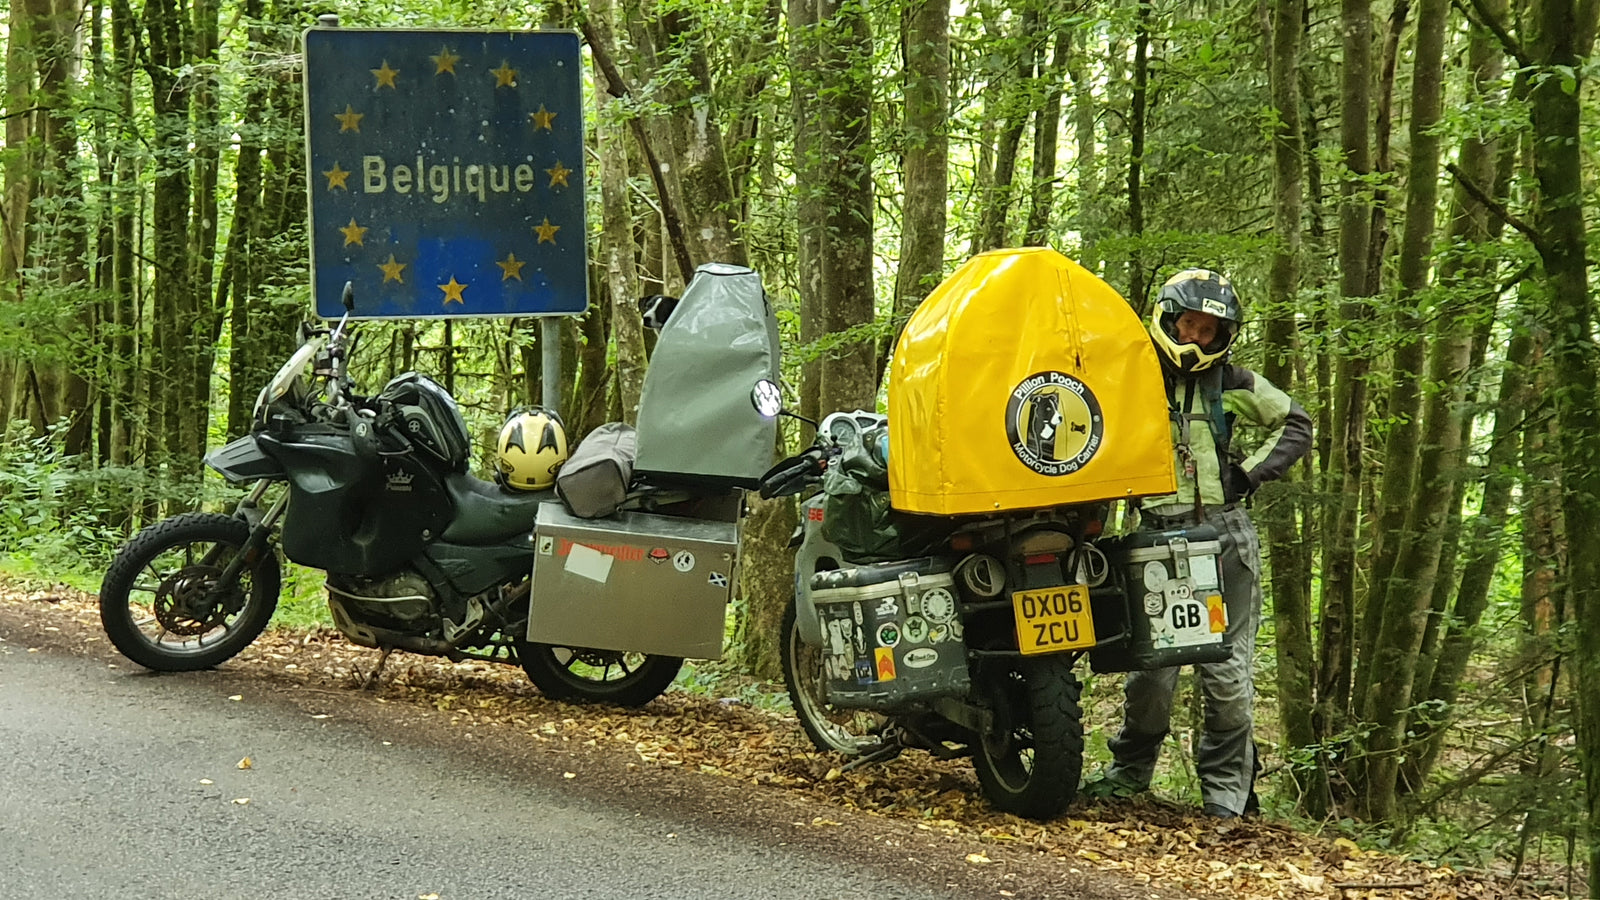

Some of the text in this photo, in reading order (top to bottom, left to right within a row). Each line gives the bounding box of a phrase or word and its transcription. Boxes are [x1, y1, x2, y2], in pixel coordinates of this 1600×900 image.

[363, 155, 534, 203] Belgique
[1014, 372, 1085, 399] Pillion Pooch
[1014, 434, 1099, 473] Motorcycle Dog Carrier
[1171, 603, 1202, 629] GB
[1033, 619, 1079, 646] ZCU
